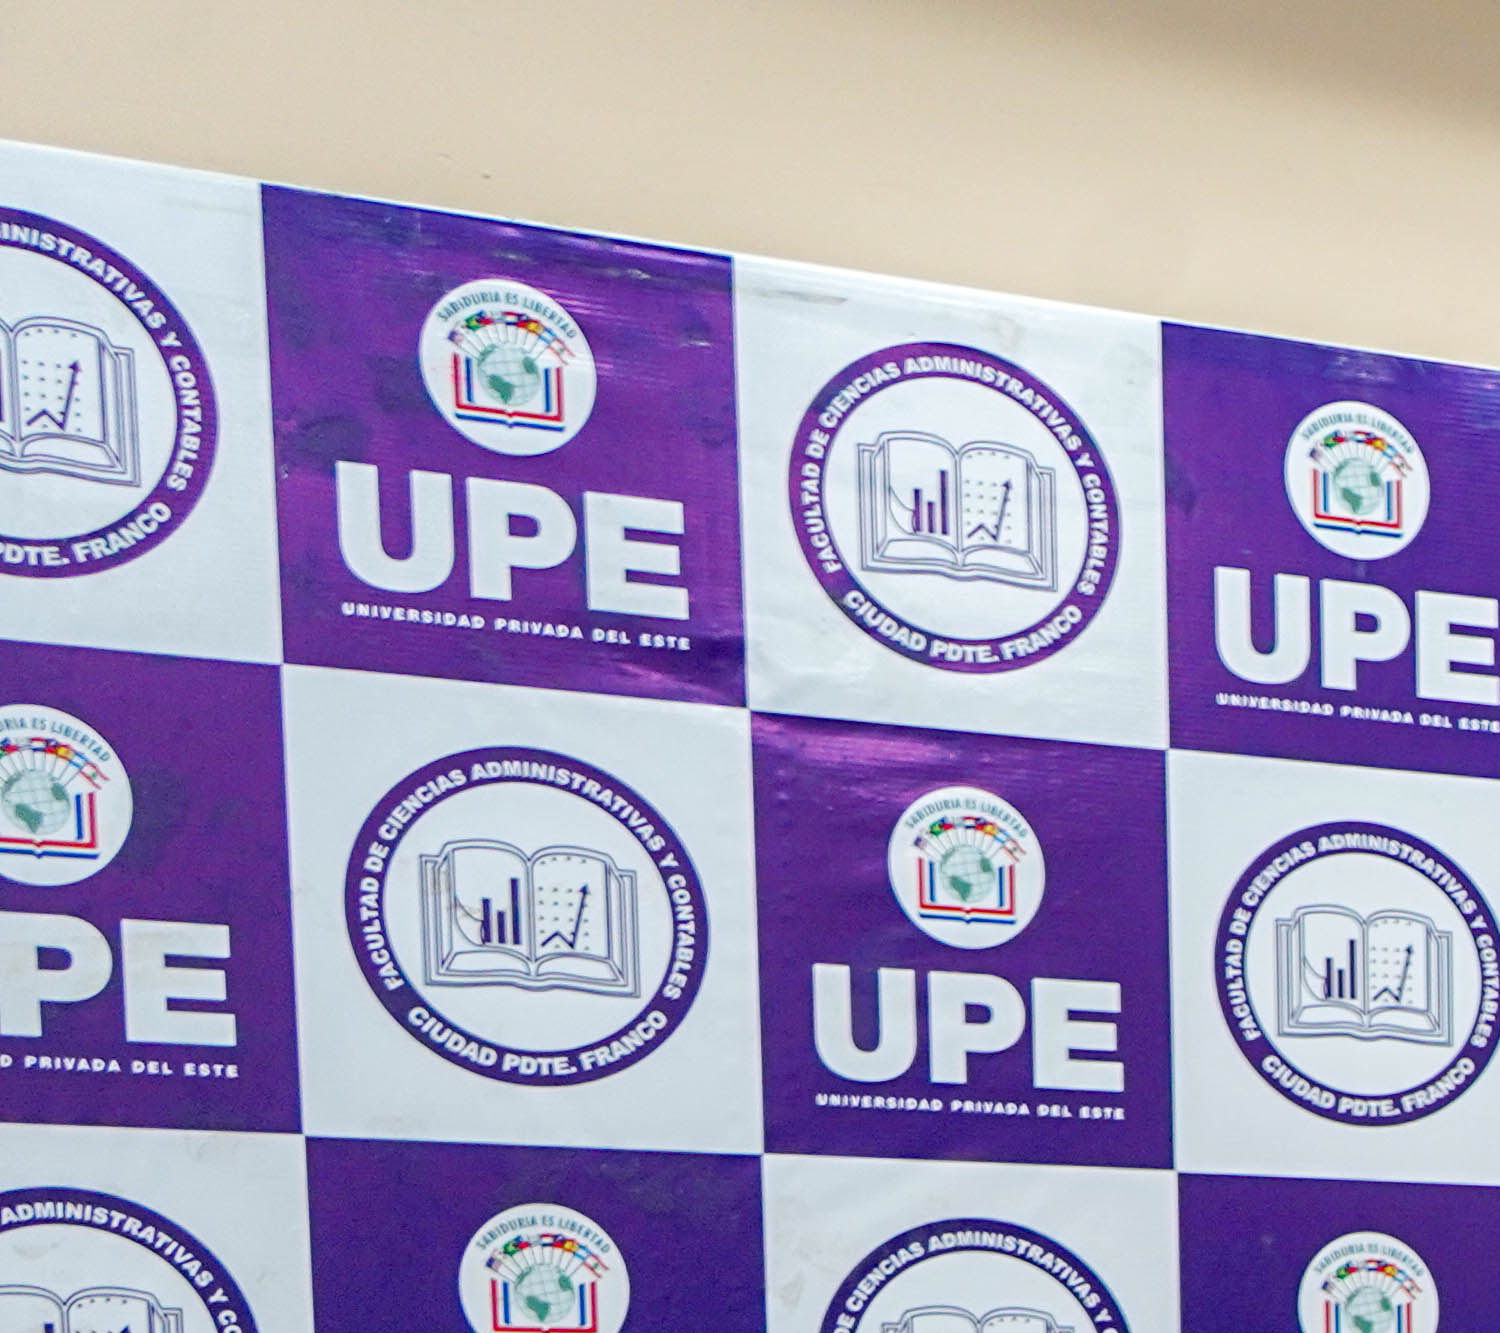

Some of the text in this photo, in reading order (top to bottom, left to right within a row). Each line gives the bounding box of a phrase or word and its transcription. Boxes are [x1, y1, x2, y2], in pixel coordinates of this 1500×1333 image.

[155, 329, 202, 495] Y CONTABLES
[73, 499, 173, 563] FRANCO
[803, 356, 1108, 599] FACULTAD DE CIENCIAS ADMINISTRATIVAS Y CONTABLES
[335, 460, 690, 623] UPE
[341, 602, 690, 651] UNIVERSIDAD PRIVADA DEL ESTE
[844, 588, 1083, 664] CIUDAD PDTE. FRANCO
[1215, 566, 1500, 709] UPE
[1217, 693, 1500, 734] UNIVERSIDAD PRIVADA DEL ESTE
[360, 760, 695, 1003] FACULTAD DE CIENCIAS ADMINISTRATIVAS Y CONTABLES
[0, 911, 238, 1048] PE
[811, 962, 1124, 1094] UPE
[23, 1053, 239, 1077] PRIVADA DEL ESTE
[406, 1003, 668, 1075] CIUDAD PDTE. FRANCO
[815, 1092, 1125, 1120] UNIVERSIDAD PRIVADA DEL ESTE
[0, 1201, 214, 1288] ADMINISTRATIVAS
[201, 1285, 230, 1310] Y
